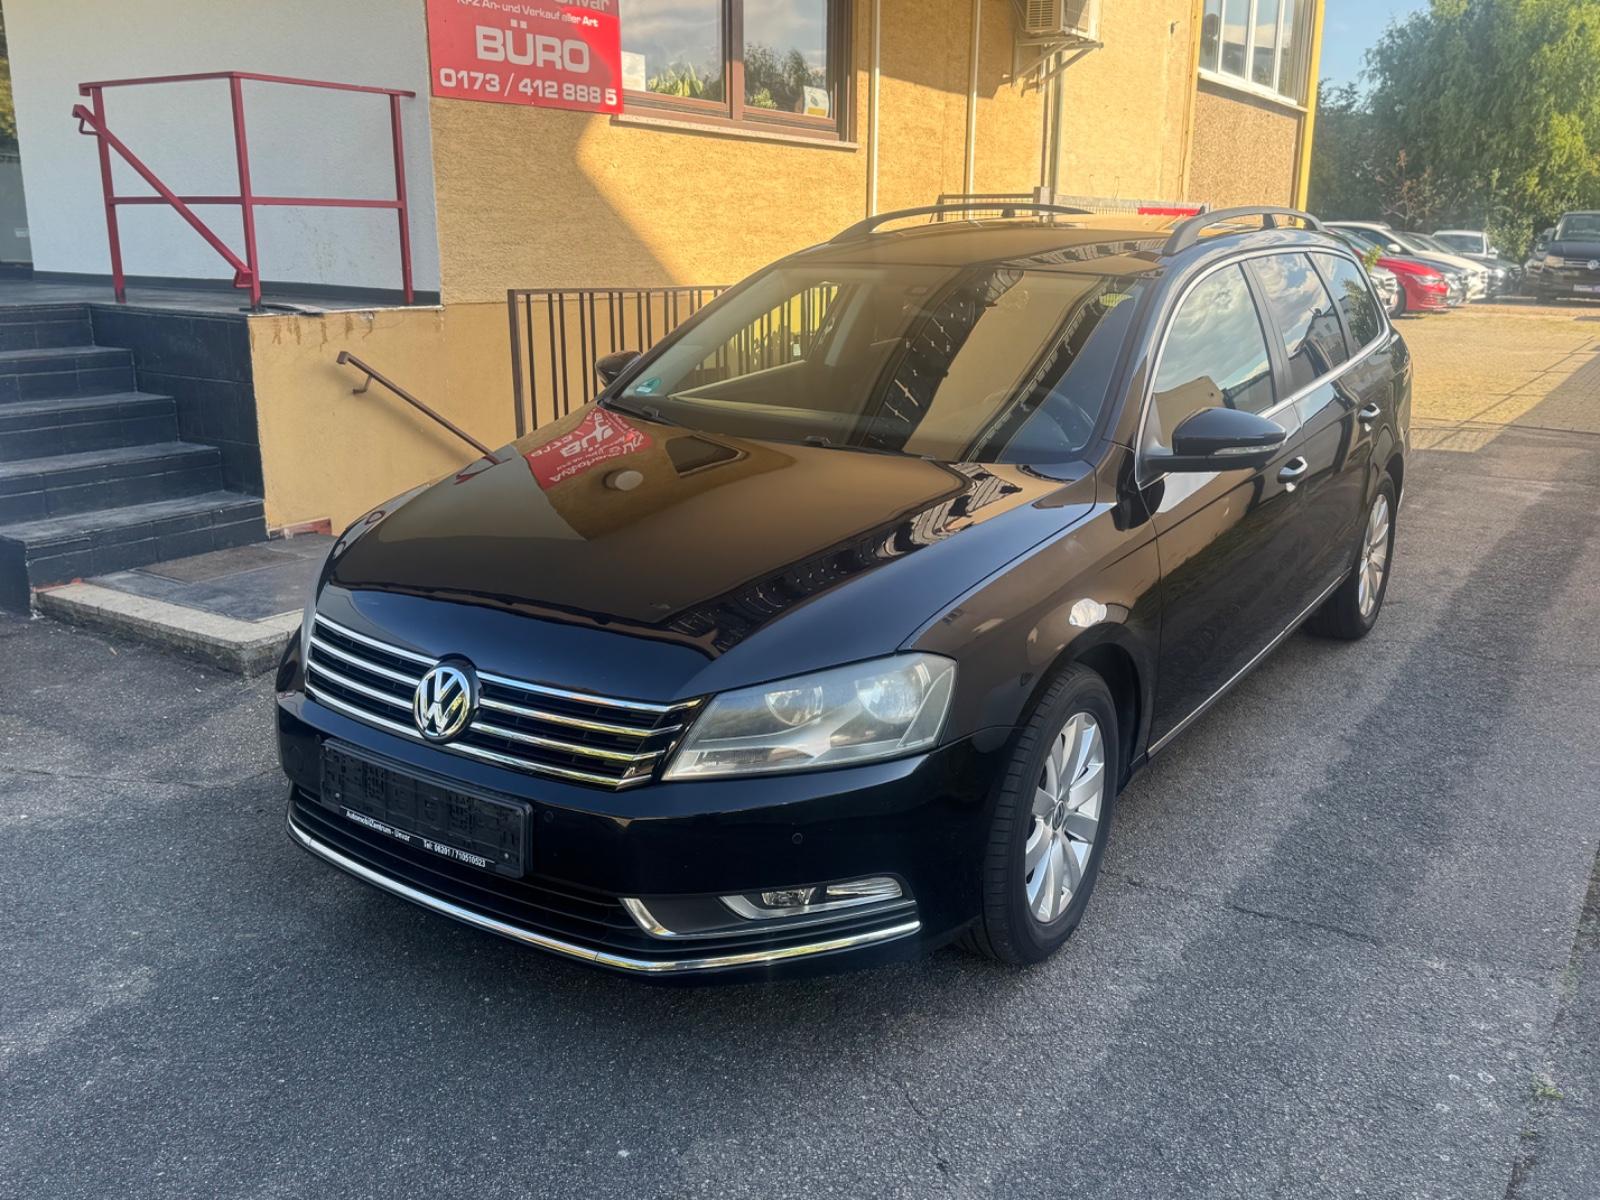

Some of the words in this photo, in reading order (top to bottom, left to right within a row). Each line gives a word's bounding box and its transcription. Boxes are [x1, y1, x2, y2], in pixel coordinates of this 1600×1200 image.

[482, 0, 501, 10] An-
[502, 4, 521, 14] und
[522, 5, 560, 21] Verkauf
[561, 14, 581, 24] aller
[582, 15, 599, 27] Art
[475, 19, 590, 73] BÜRO
[439, 67, 500, 92] 0173
[518, 78, 558, 99] 412
[562, 82, 601, 104] 888
[604, 88, 617, 106] 5
